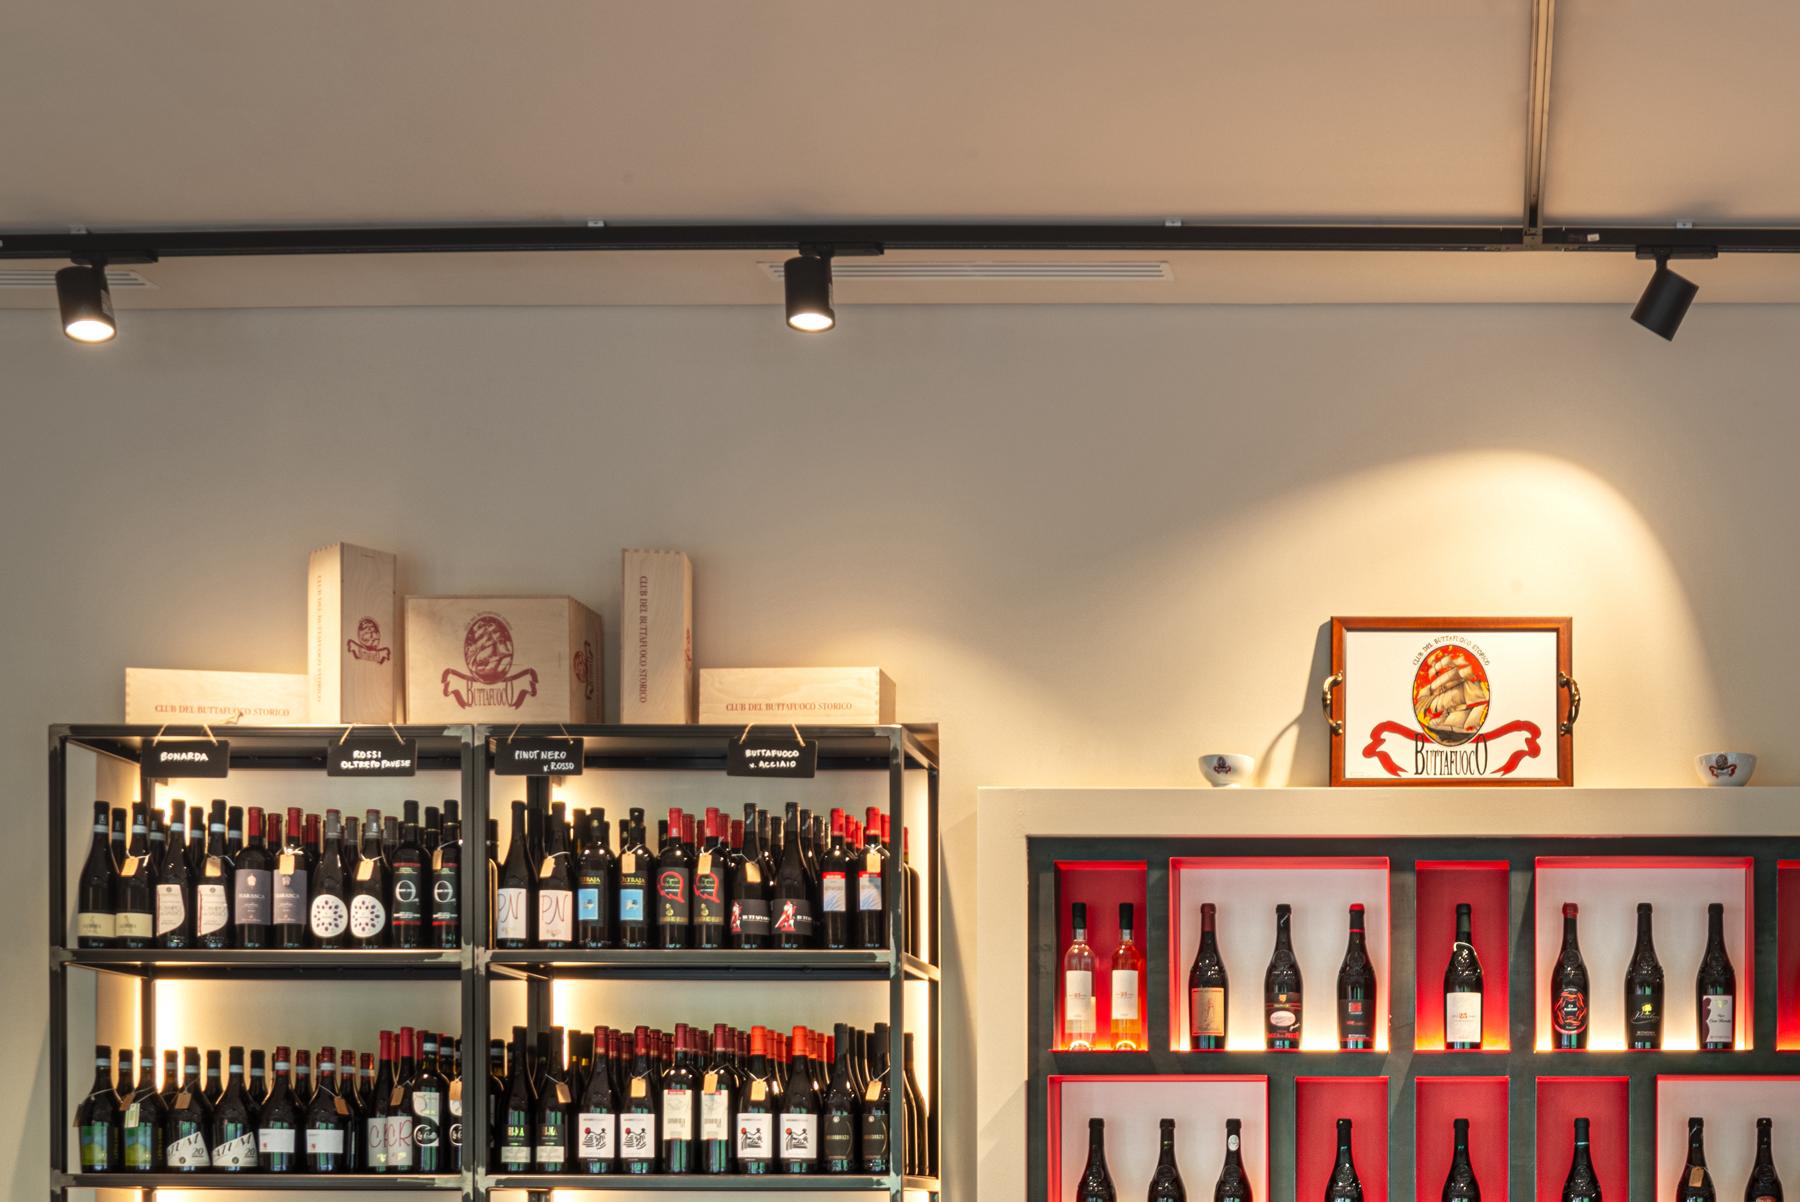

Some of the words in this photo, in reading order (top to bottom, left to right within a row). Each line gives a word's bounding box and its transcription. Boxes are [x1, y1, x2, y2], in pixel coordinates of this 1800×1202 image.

[640, 575, 648, 597] CLUB
[640, 598, 648, 614] DEL
[640, 616, 648, 668] BUTTAFUOCO
[640, 669, 648, 703] STORICO
[466, 680, 515, 708] BUTTAFUOCO
[154, 704, 177, 714] CLUB
[178, 705, 195, 714] DEL
[197, 705, 251, 715] BUTTAFUOCO
[253, 707, 290, 717] STORICO
[726, 703, 747, 712] CLUB
[748, 703, 763, 712] DEL
[765, 703, 816, 712] BUTTAFUOCO
[817, 702, 852, 711] STORICO
[160, 751, 209, 762] BONARDA
[353, 751, 381, 760] ROSSI
[515, 751, 538, 760] PINOT
[540, 751, 566, 760] NERO
[745, 749, 799, 758] BUTTAFUOCO
[1414, 733, 1488, 776] BUTTAFUOCO
[381, 759, 411, 770] PAVESE
[550, 761, 574, 771] ROSSO
[759, 760, 796, 768] ACCIAIO
